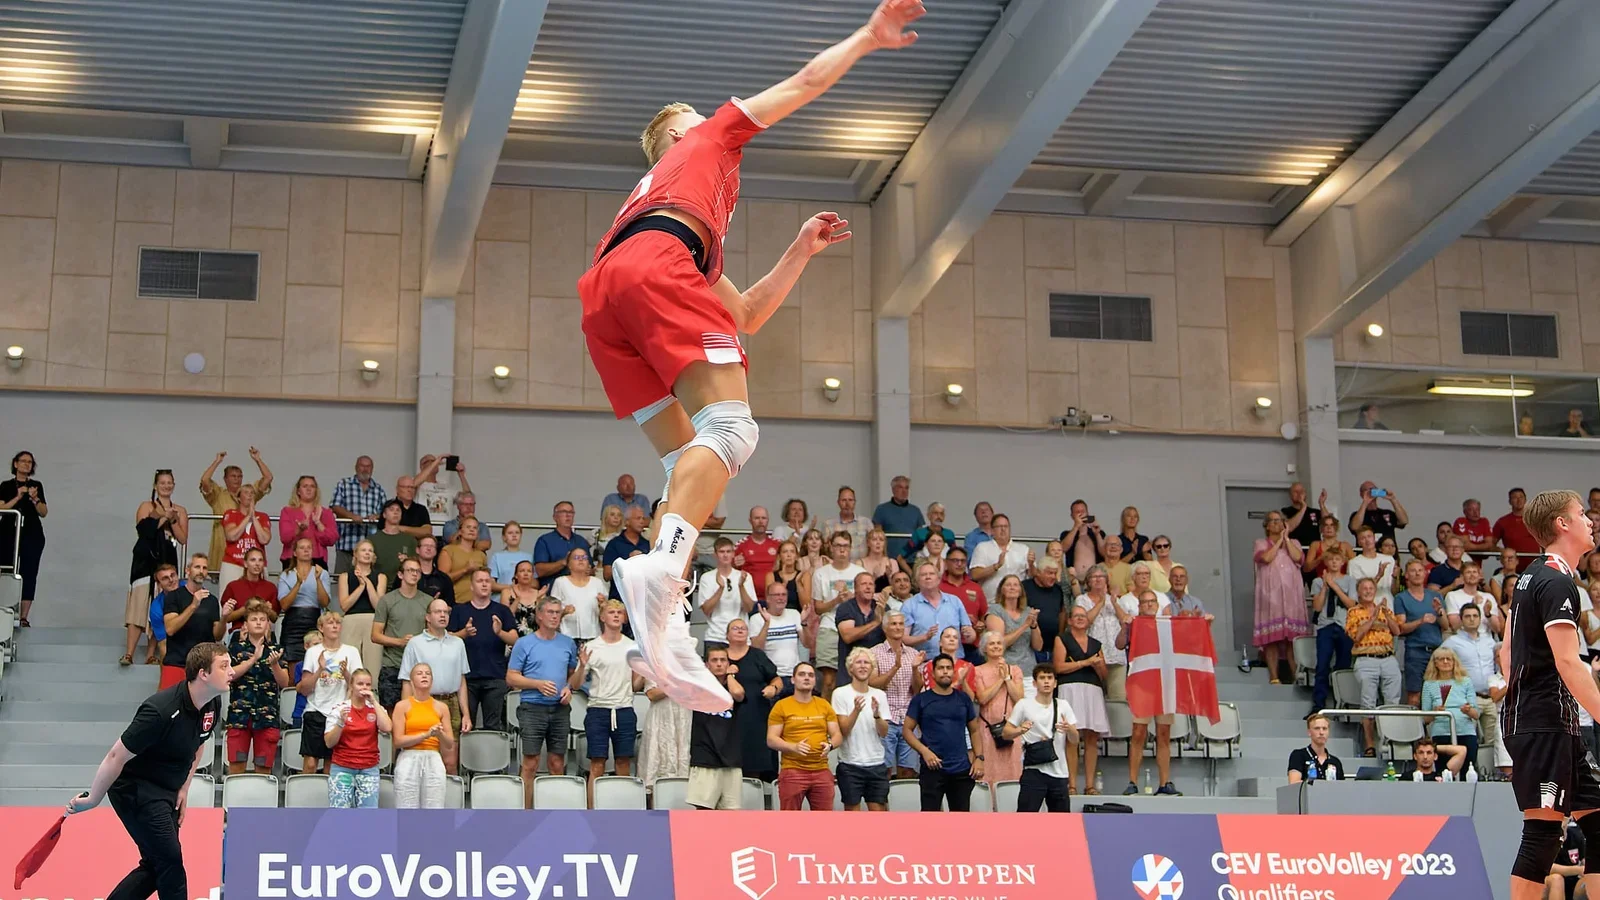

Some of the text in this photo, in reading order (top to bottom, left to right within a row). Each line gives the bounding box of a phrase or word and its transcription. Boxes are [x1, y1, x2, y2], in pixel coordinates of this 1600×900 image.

[257, 851, 639, 900] EuroVolley.TV
[1211, 852, 1457, 880] CEV EuroVolley 2023
[1217, 883, 1335, 900] Qualifiers
